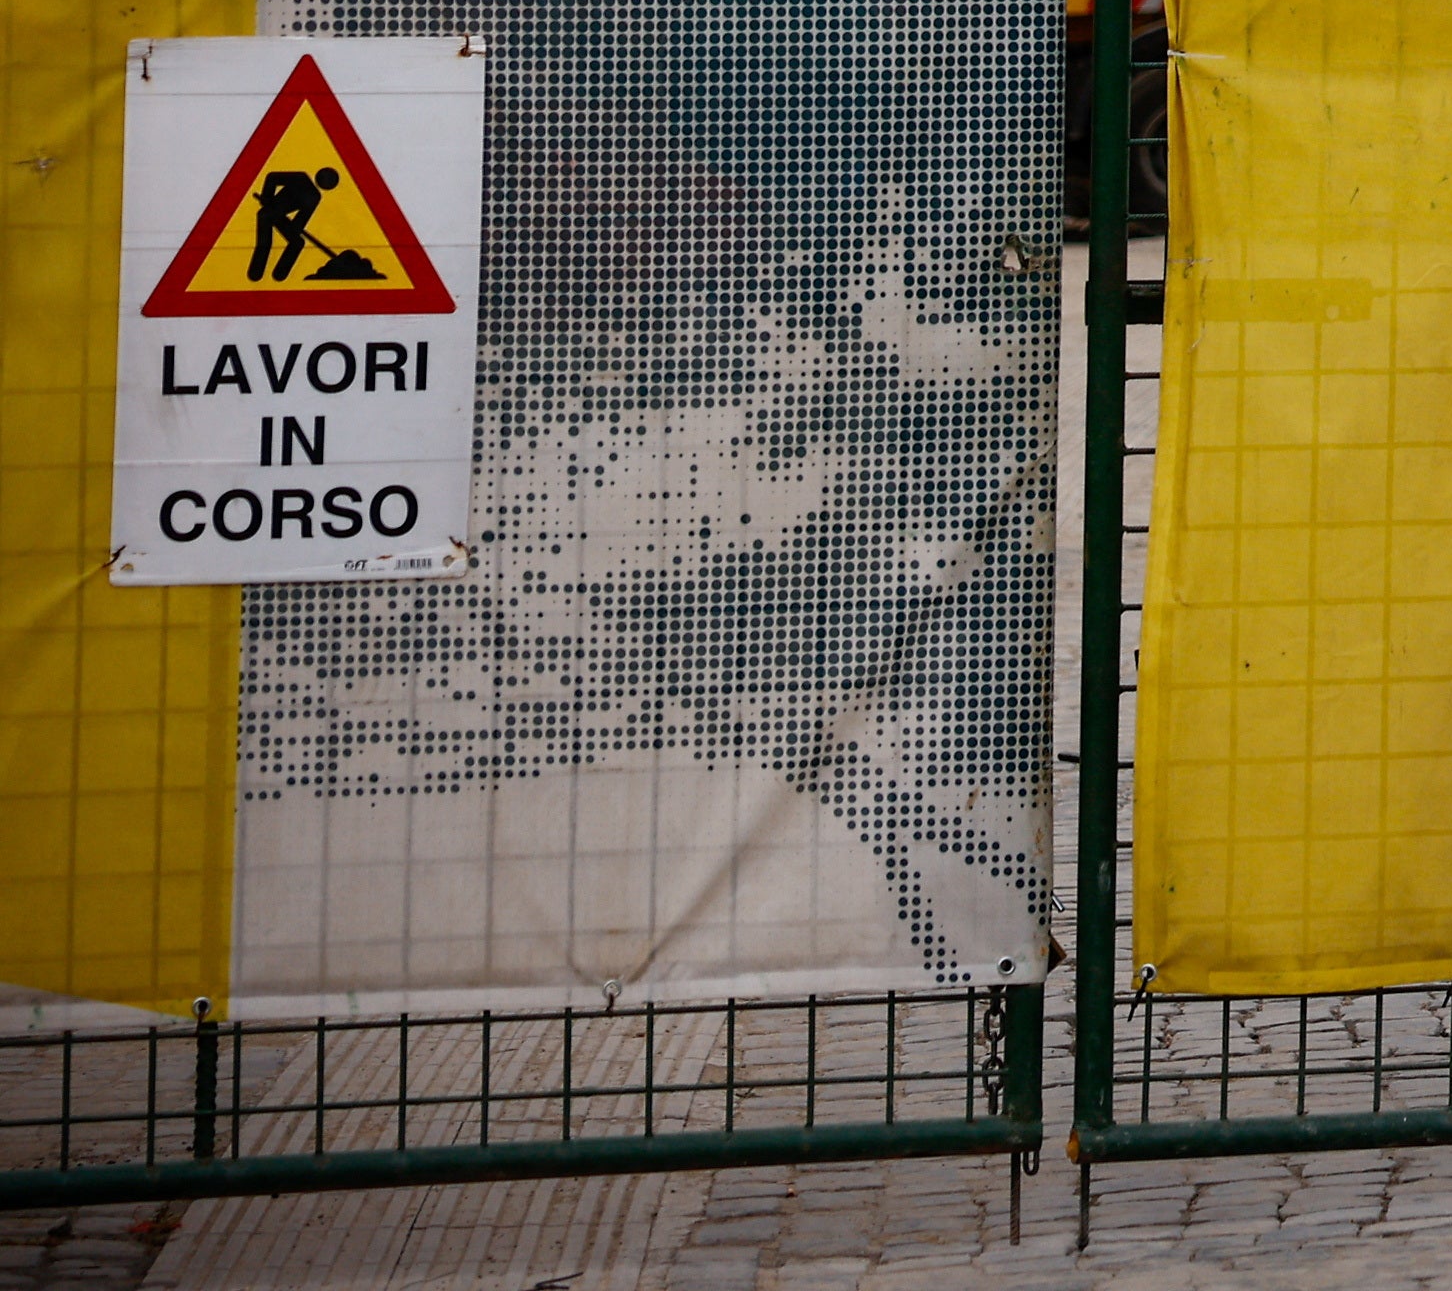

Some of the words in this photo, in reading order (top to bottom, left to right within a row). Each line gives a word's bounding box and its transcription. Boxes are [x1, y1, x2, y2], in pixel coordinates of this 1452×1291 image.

[161, 341, 429, 395] LAVORI
[259, 415, 326, 466] IN
[159, 485, 419, 541] CORSO
